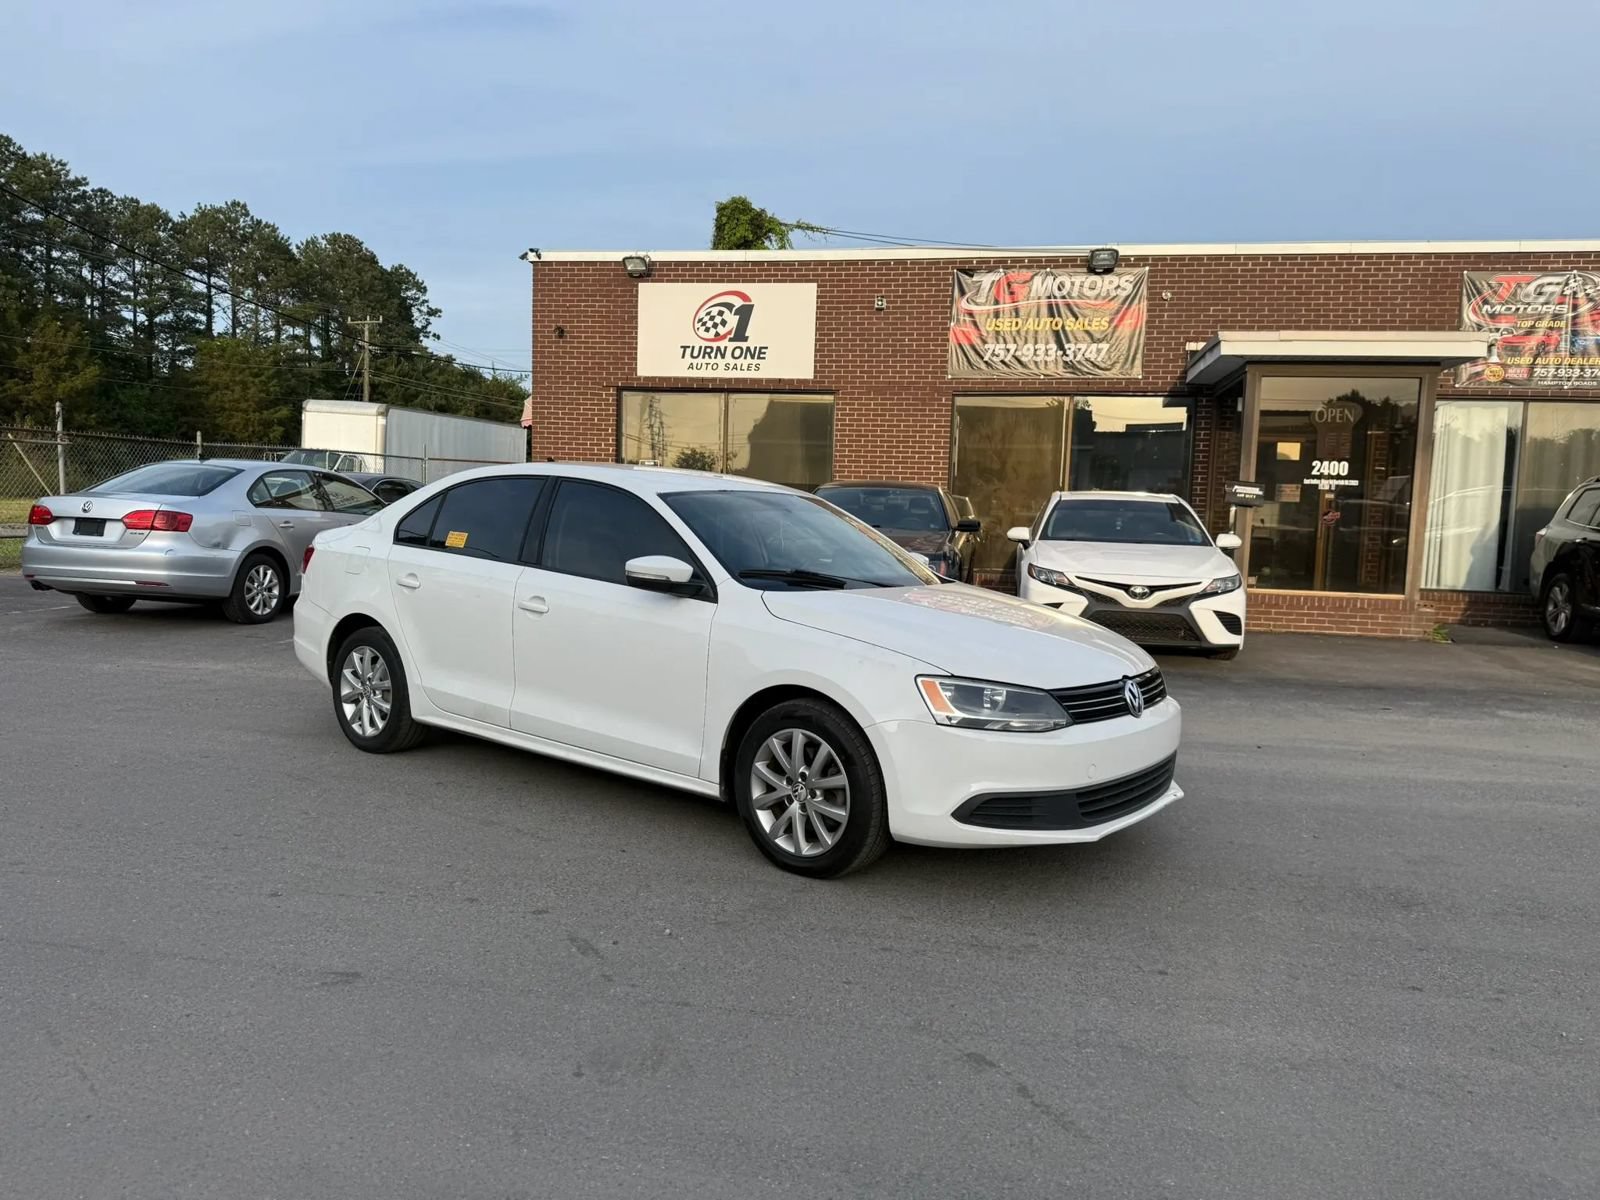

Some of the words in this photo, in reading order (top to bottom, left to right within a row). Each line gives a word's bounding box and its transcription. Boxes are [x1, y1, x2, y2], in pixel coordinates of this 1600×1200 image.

[1028, 275, 1134, 297] MOTORS
[1482, 304, 1568, 314] MOTORS
[985, 317, 1022, 331] USED
[1023, 317, 1063, 331] AUTO
[1065, 317, 1110, 331] SALES
[1535, 320, 1566, 328] GRADE
[680, 345, 729, 360] TURN
[731, 346, 769, 360] ONE
[983, 343, 1110, 362] 757-933-3747
[687, 362, 719, 371] AUTO
[723, 362, 761, 372] SALES
[1507, 357, 1533, 365] USED
[1535, 357, 1561, 365] AUTO
[1315, 407, 1355, 423] OPEN
[1311, 460, 1349, 476] 2400
